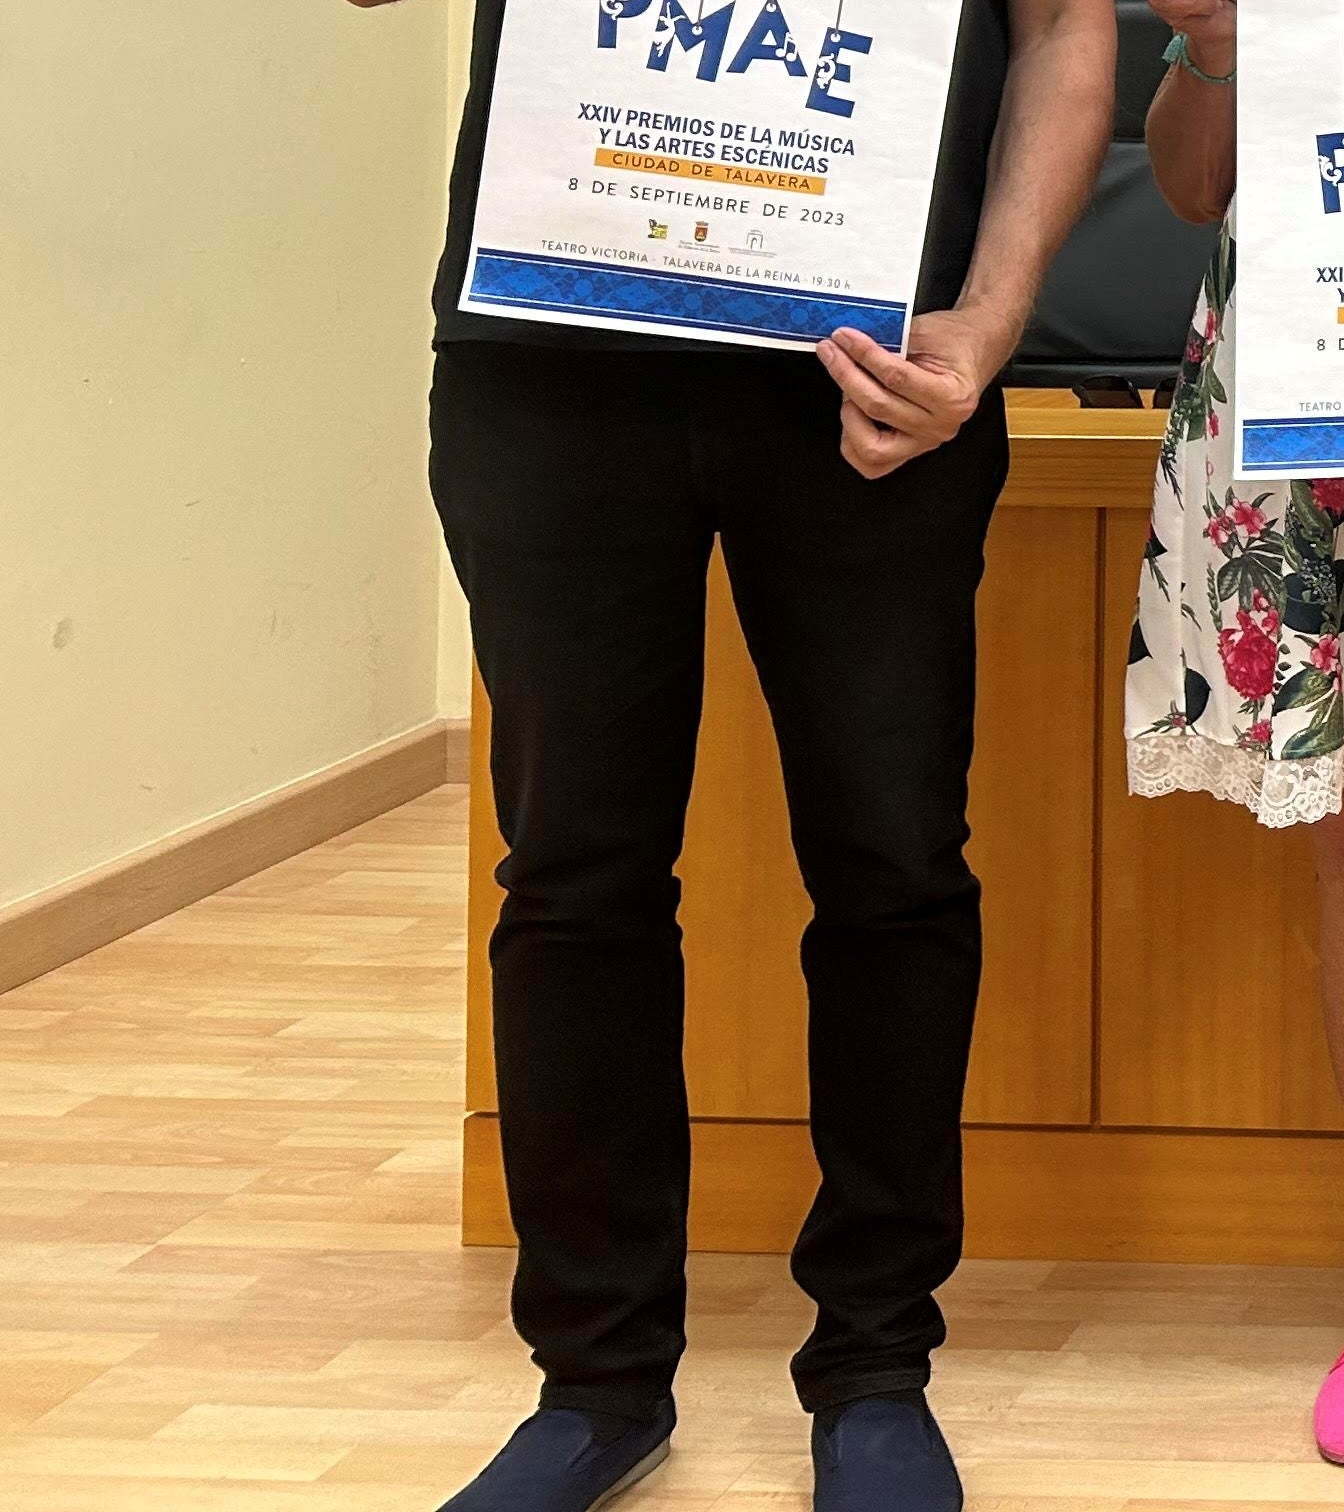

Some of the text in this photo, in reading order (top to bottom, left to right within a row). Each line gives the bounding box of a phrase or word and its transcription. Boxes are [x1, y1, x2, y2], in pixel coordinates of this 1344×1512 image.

[578, 102, 856, 155] XXIV PREMIOS DE LA MÚSICA
[599, 128, 829, 173] Y LAS ARTES ESCÉNICAS
[612, 153, 810, 190] CIUDAD DE TALAVERA
[568, 178, 844, 226] 8 DE SEPTIEMBRE DE 2023
[541, 239, 587, 255] TEATRO
[591, 246, 648, 263] VICTORIA
[663, 256, 722, 273] TALAVERA
[726, 265, 741, 276] DE
[746, 267, 761, 278] LA
[764, 269, 800, 284] REINA
[1317, 339, 1326, 350] 8
[1299, 401, 1341, 412] TEATRO
